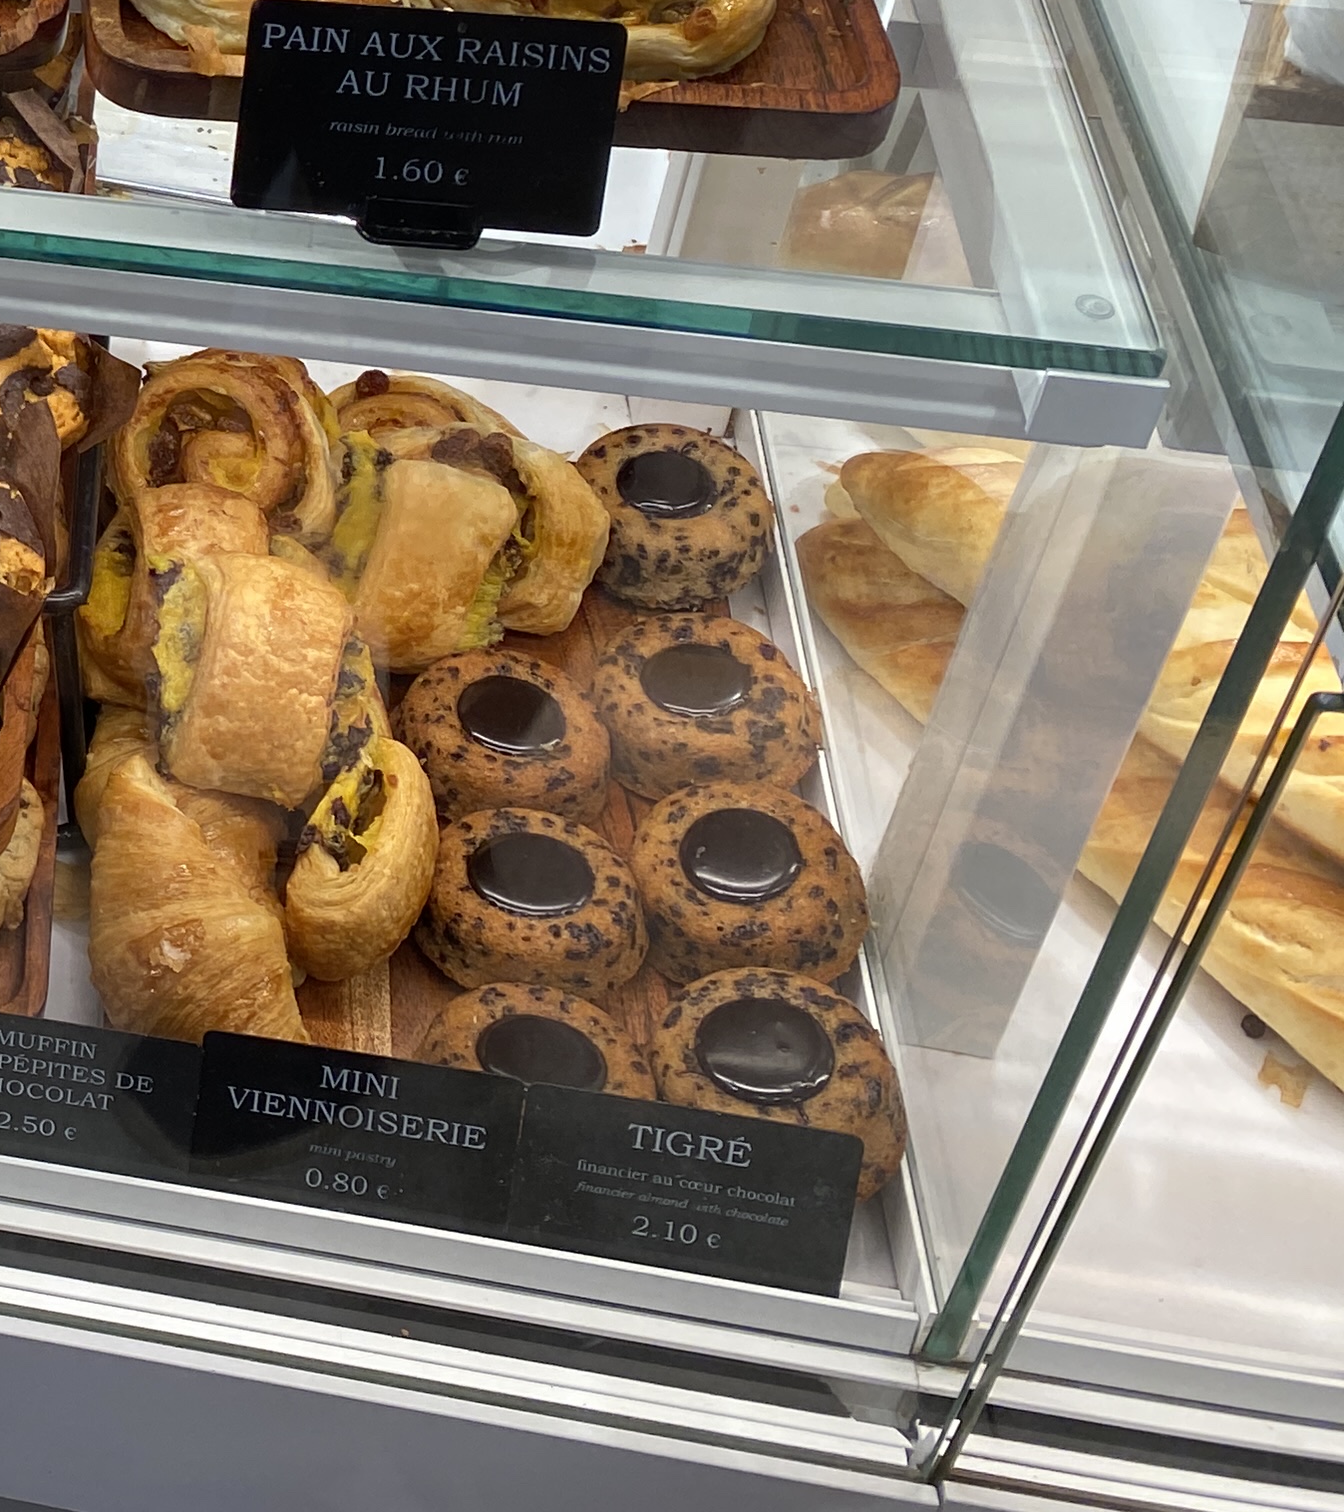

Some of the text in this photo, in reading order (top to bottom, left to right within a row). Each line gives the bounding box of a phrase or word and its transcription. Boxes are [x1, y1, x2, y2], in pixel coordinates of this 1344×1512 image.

[262, 23, 611, 74] PAIN AUX RAISINS
[336, 70, 523, 107] AU RHUM
[329, 121, 379, 134] raisin
[386, 122, 437, 139] bread
[374, 157, 469, 185] 1.60 €
[115, 1072, 154, 1093] DE
[320, 1065, 401, 1100] MINI
[64, 1127, 76, 1140] €
[228, 1086, 487, 1150] VIENNOISERIE
[629, 1123, 752, 1168] TIGRÉ
[305, 1168, 368, 1195] 0.80
[577, 1159, 649, 1182] financier
[653, 1175, 673, 1187] au
[727, 1186, 795, 1207] chocolat
[632, 1216, 721, 1249] 2.10 €
